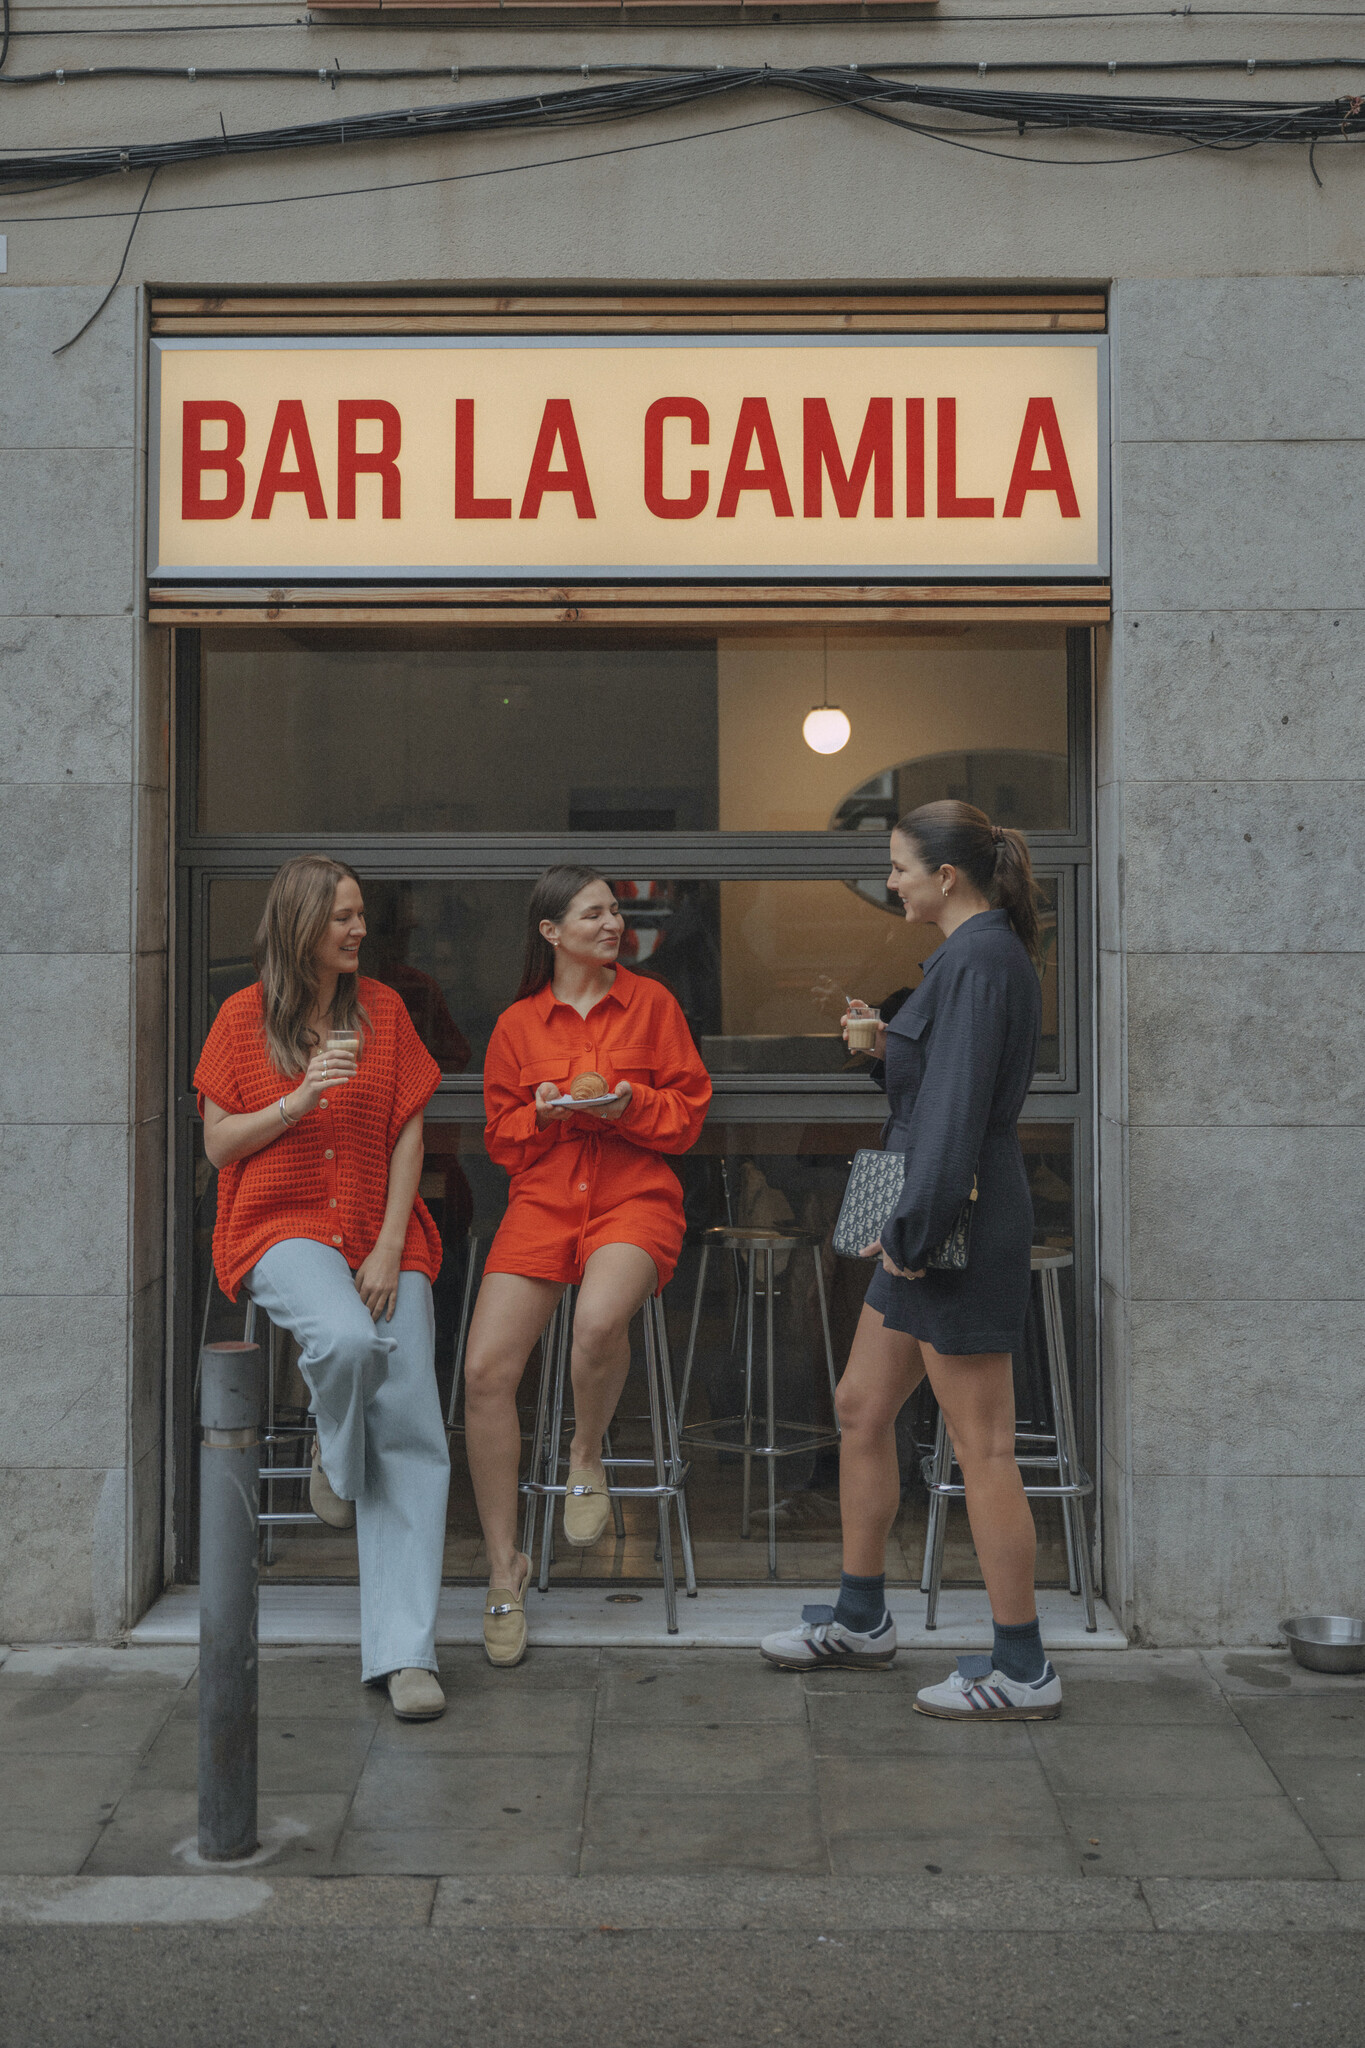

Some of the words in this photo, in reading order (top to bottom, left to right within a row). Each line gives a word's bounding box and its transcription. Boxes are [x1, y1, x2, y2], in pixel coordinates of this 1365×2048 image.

[182, 400, 402, 520] BAR
[455, 398, 597, 520] LA
[644, 396, 1081, 520] CAMILA
